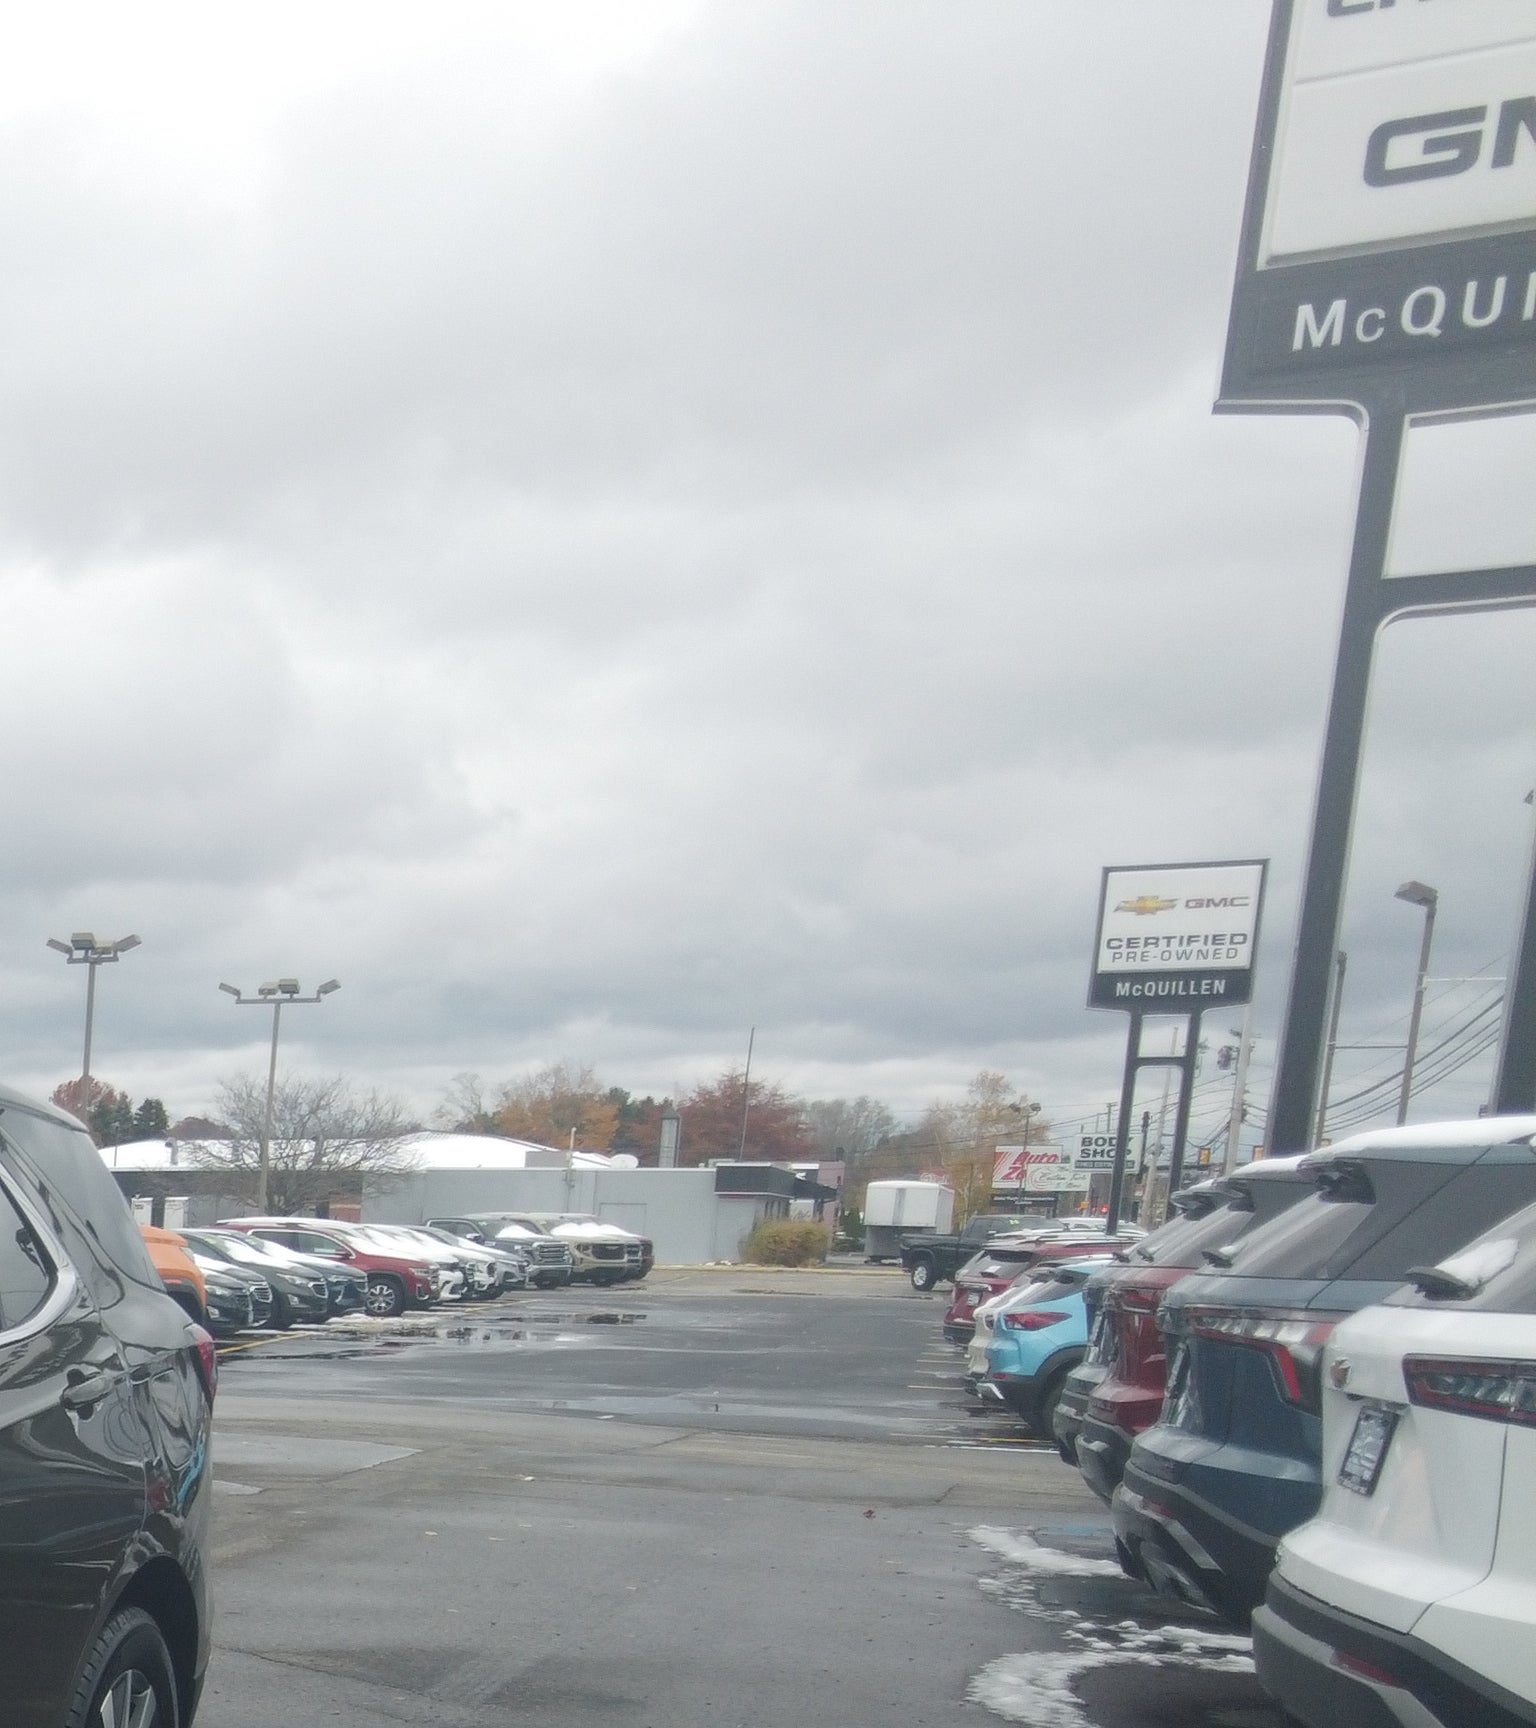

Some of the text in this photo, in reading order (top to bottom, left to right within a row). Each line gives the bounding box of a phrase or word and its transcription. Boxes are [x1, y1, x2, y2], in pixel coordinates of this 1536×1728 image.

[1184, 896, 1250, 910] GMC
[1106, 933, 1248, 950] CERTIFIED
[1111, 947, 1239, 963] PRE-OWNED
[1116, 979, 1227, 997] McQUILLEN
[1012, 1151, 1059, 1164] Auto
